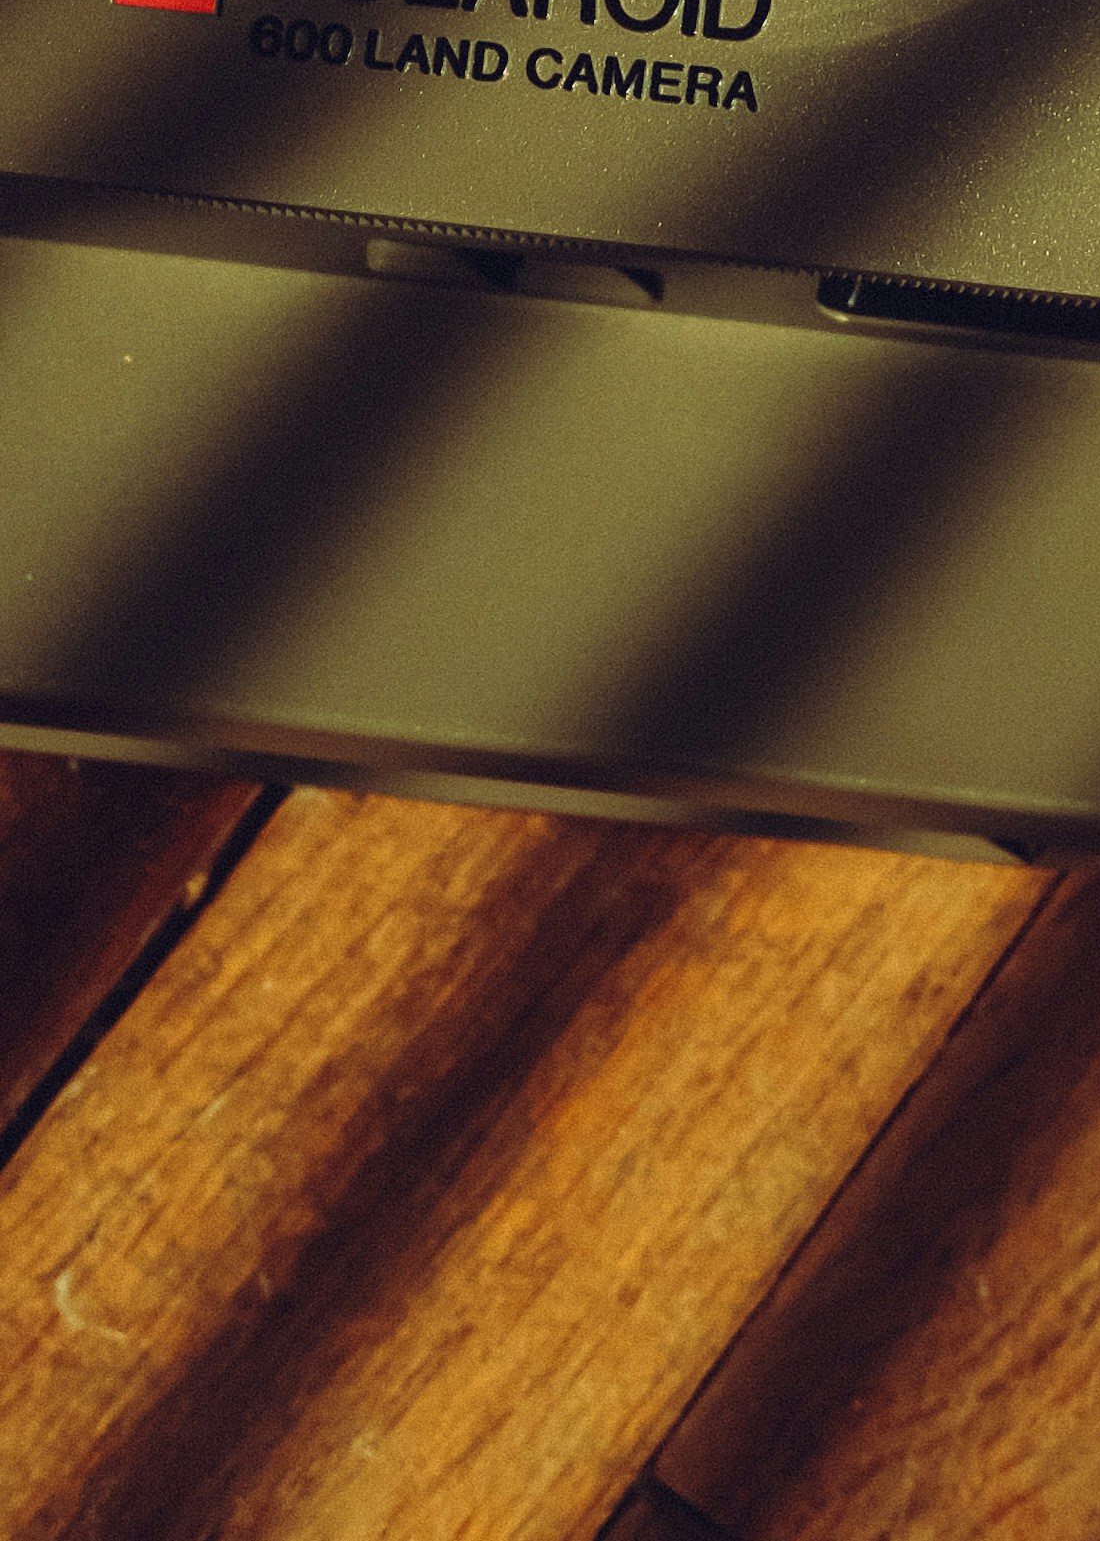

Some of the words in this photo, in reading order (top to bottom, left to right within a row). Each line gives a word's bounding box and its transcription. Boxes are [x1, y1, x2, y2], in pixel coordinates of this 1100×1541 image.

[250, 14, 353, 64] 600
[363, 28, 508, 81] LAND
[526, 47, 758, 112] CAMERA
